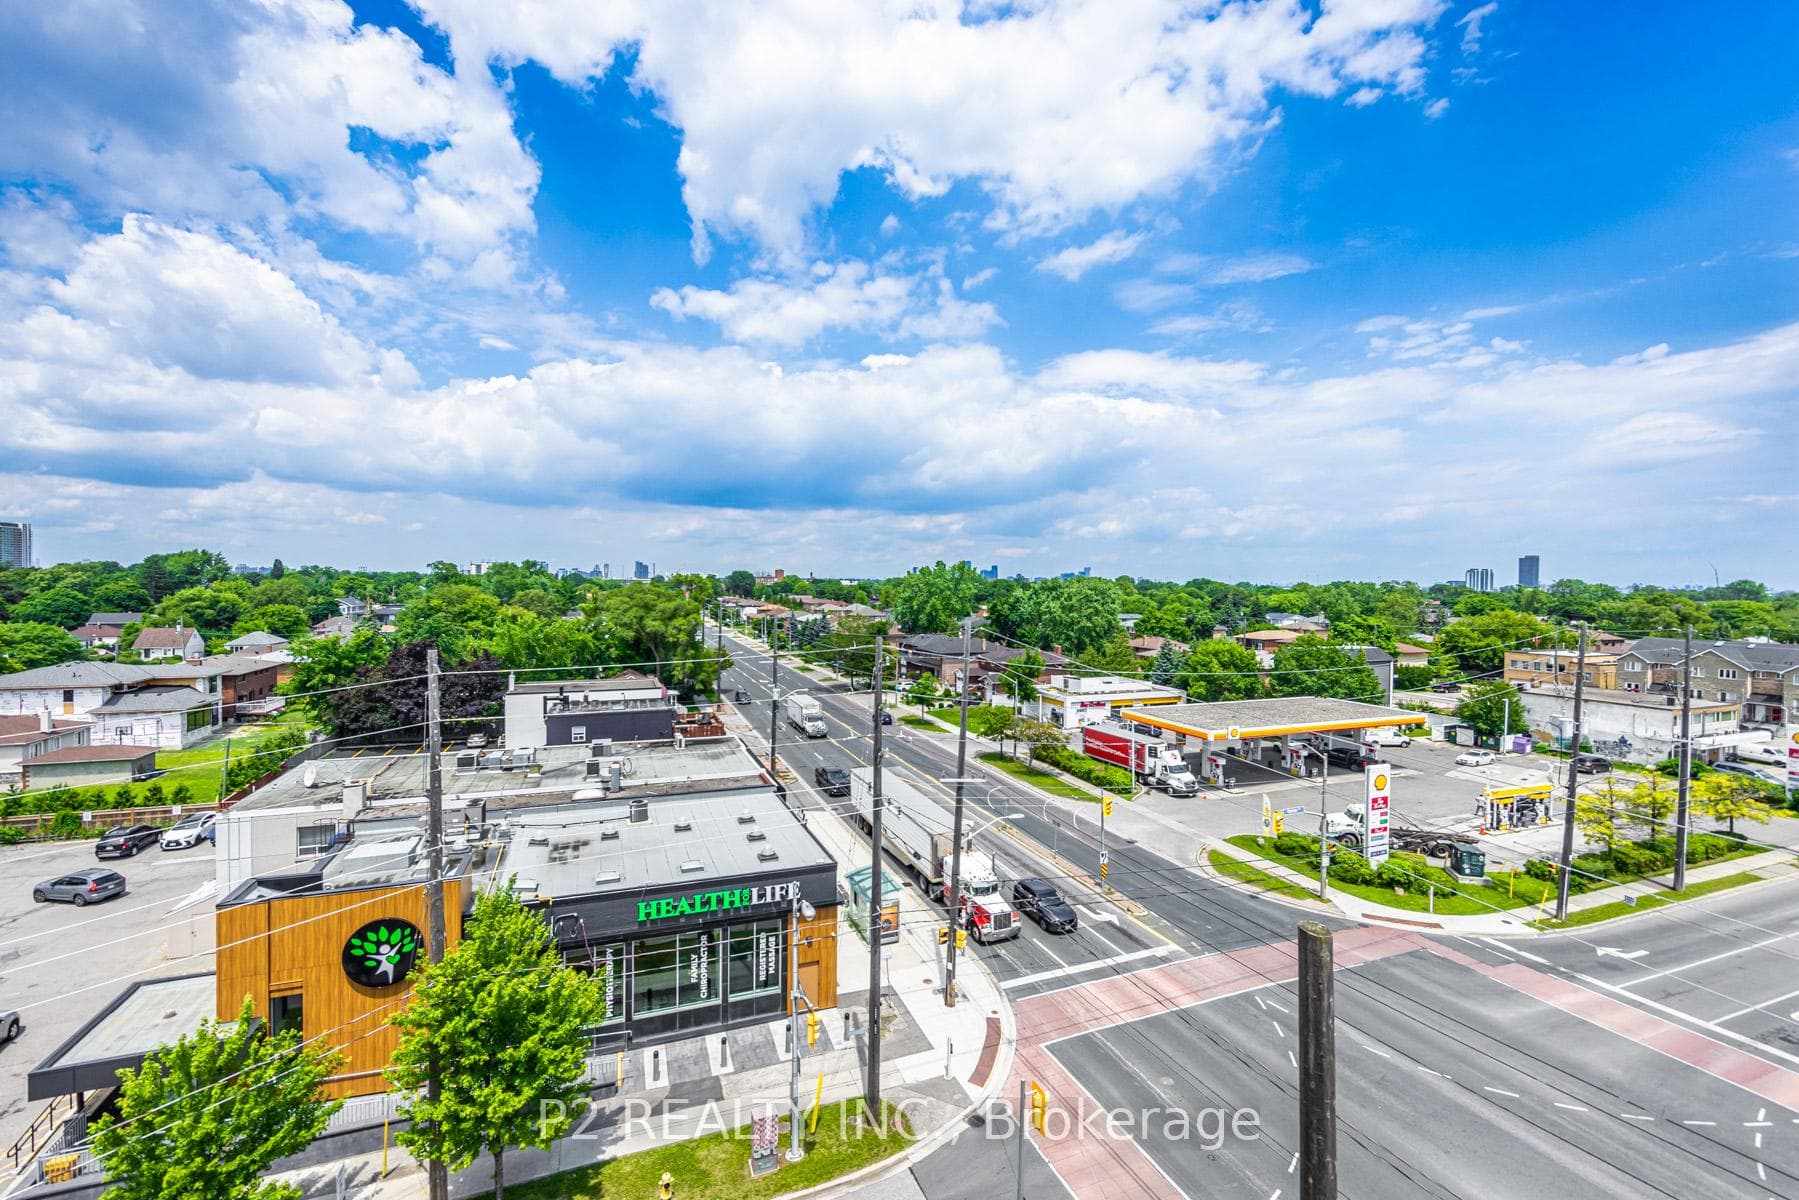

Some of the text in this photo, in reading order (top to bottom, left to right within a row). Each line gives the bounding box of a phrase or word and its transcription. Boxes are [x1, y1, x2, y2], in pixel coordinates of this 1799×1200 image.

[637, 881, 801, 921] HEALTH FOR LIFE
[700, 934, 708, 998] CHIROPRACTOR
[759, 932, 767, 981] REGISTERED
[768, 935, 776, 974] MASSAGE
